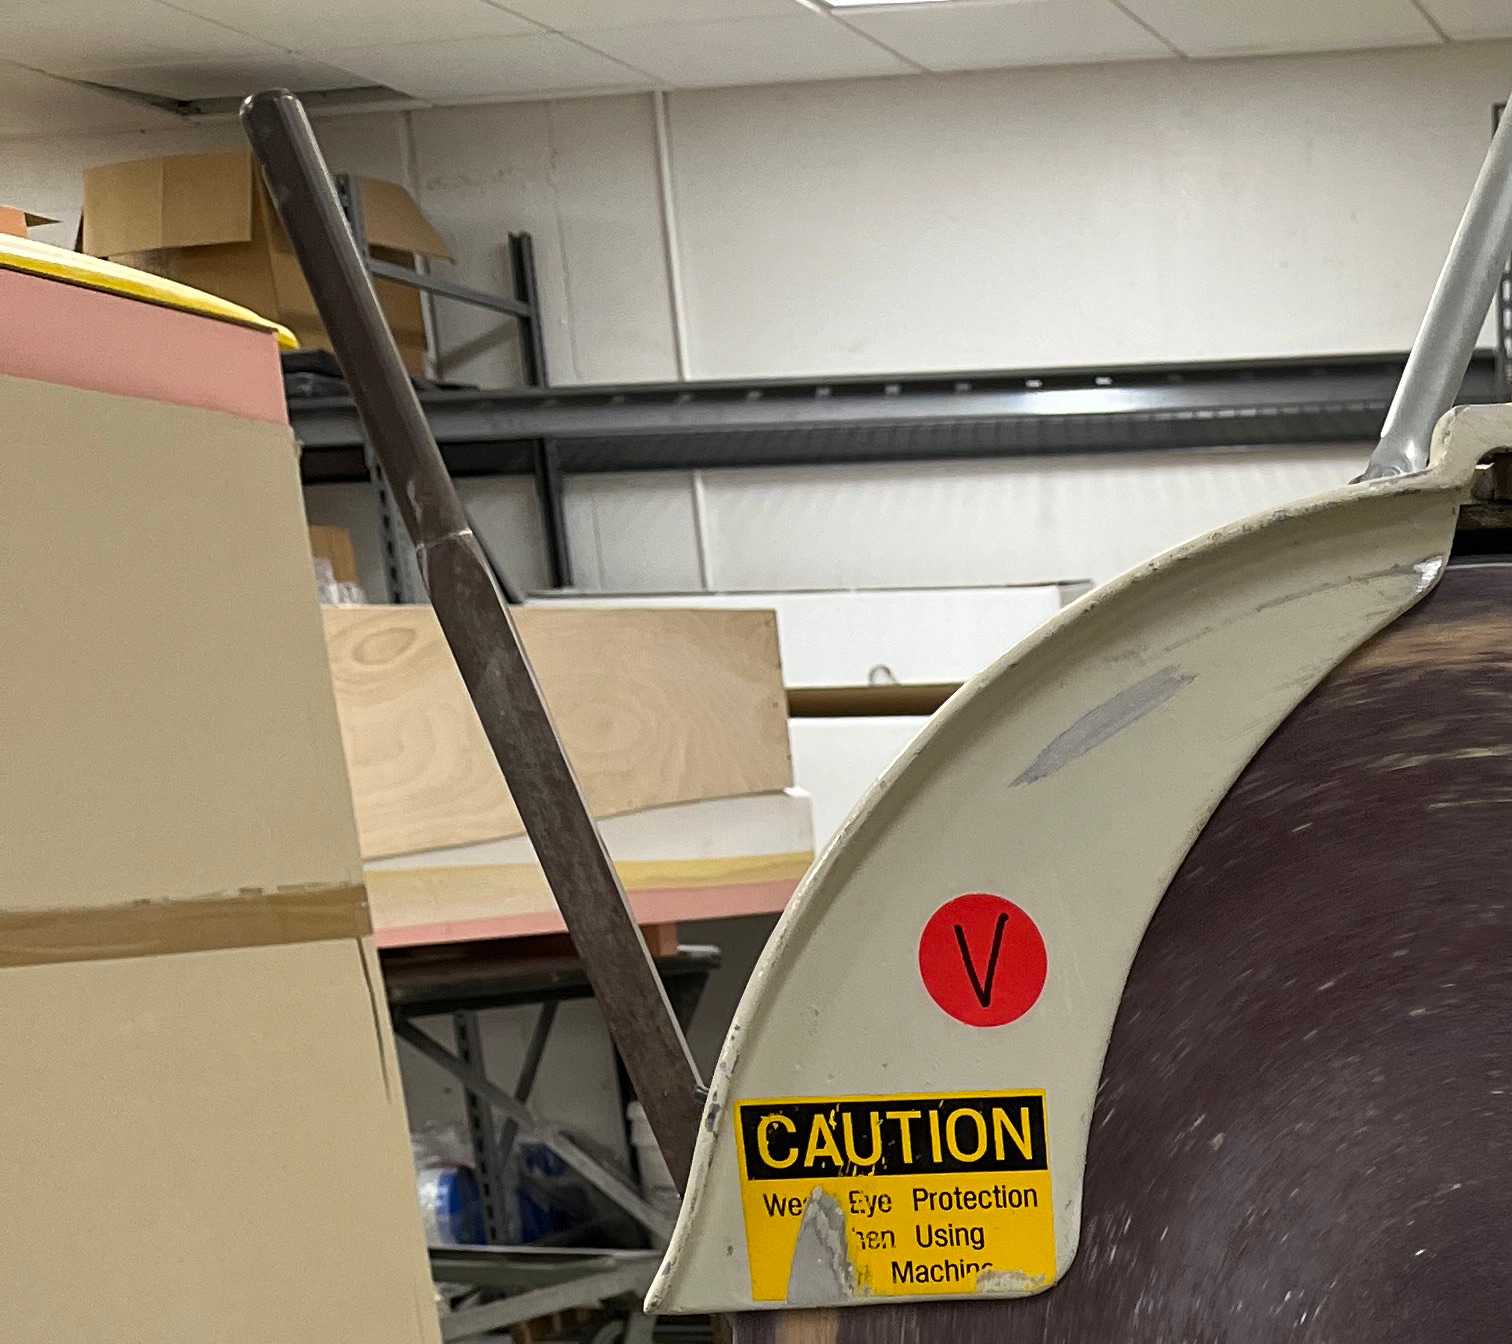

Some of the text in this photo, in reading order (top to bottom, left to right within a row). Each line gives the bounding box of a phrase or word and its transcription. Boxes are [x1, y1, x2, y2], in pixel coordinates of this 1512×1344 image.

[757, 1106, 1033, 1169] CAUTION
[763, 1185, 1038, 1217] We Eye Protection
[915, 1224, 985, 1250] Using
